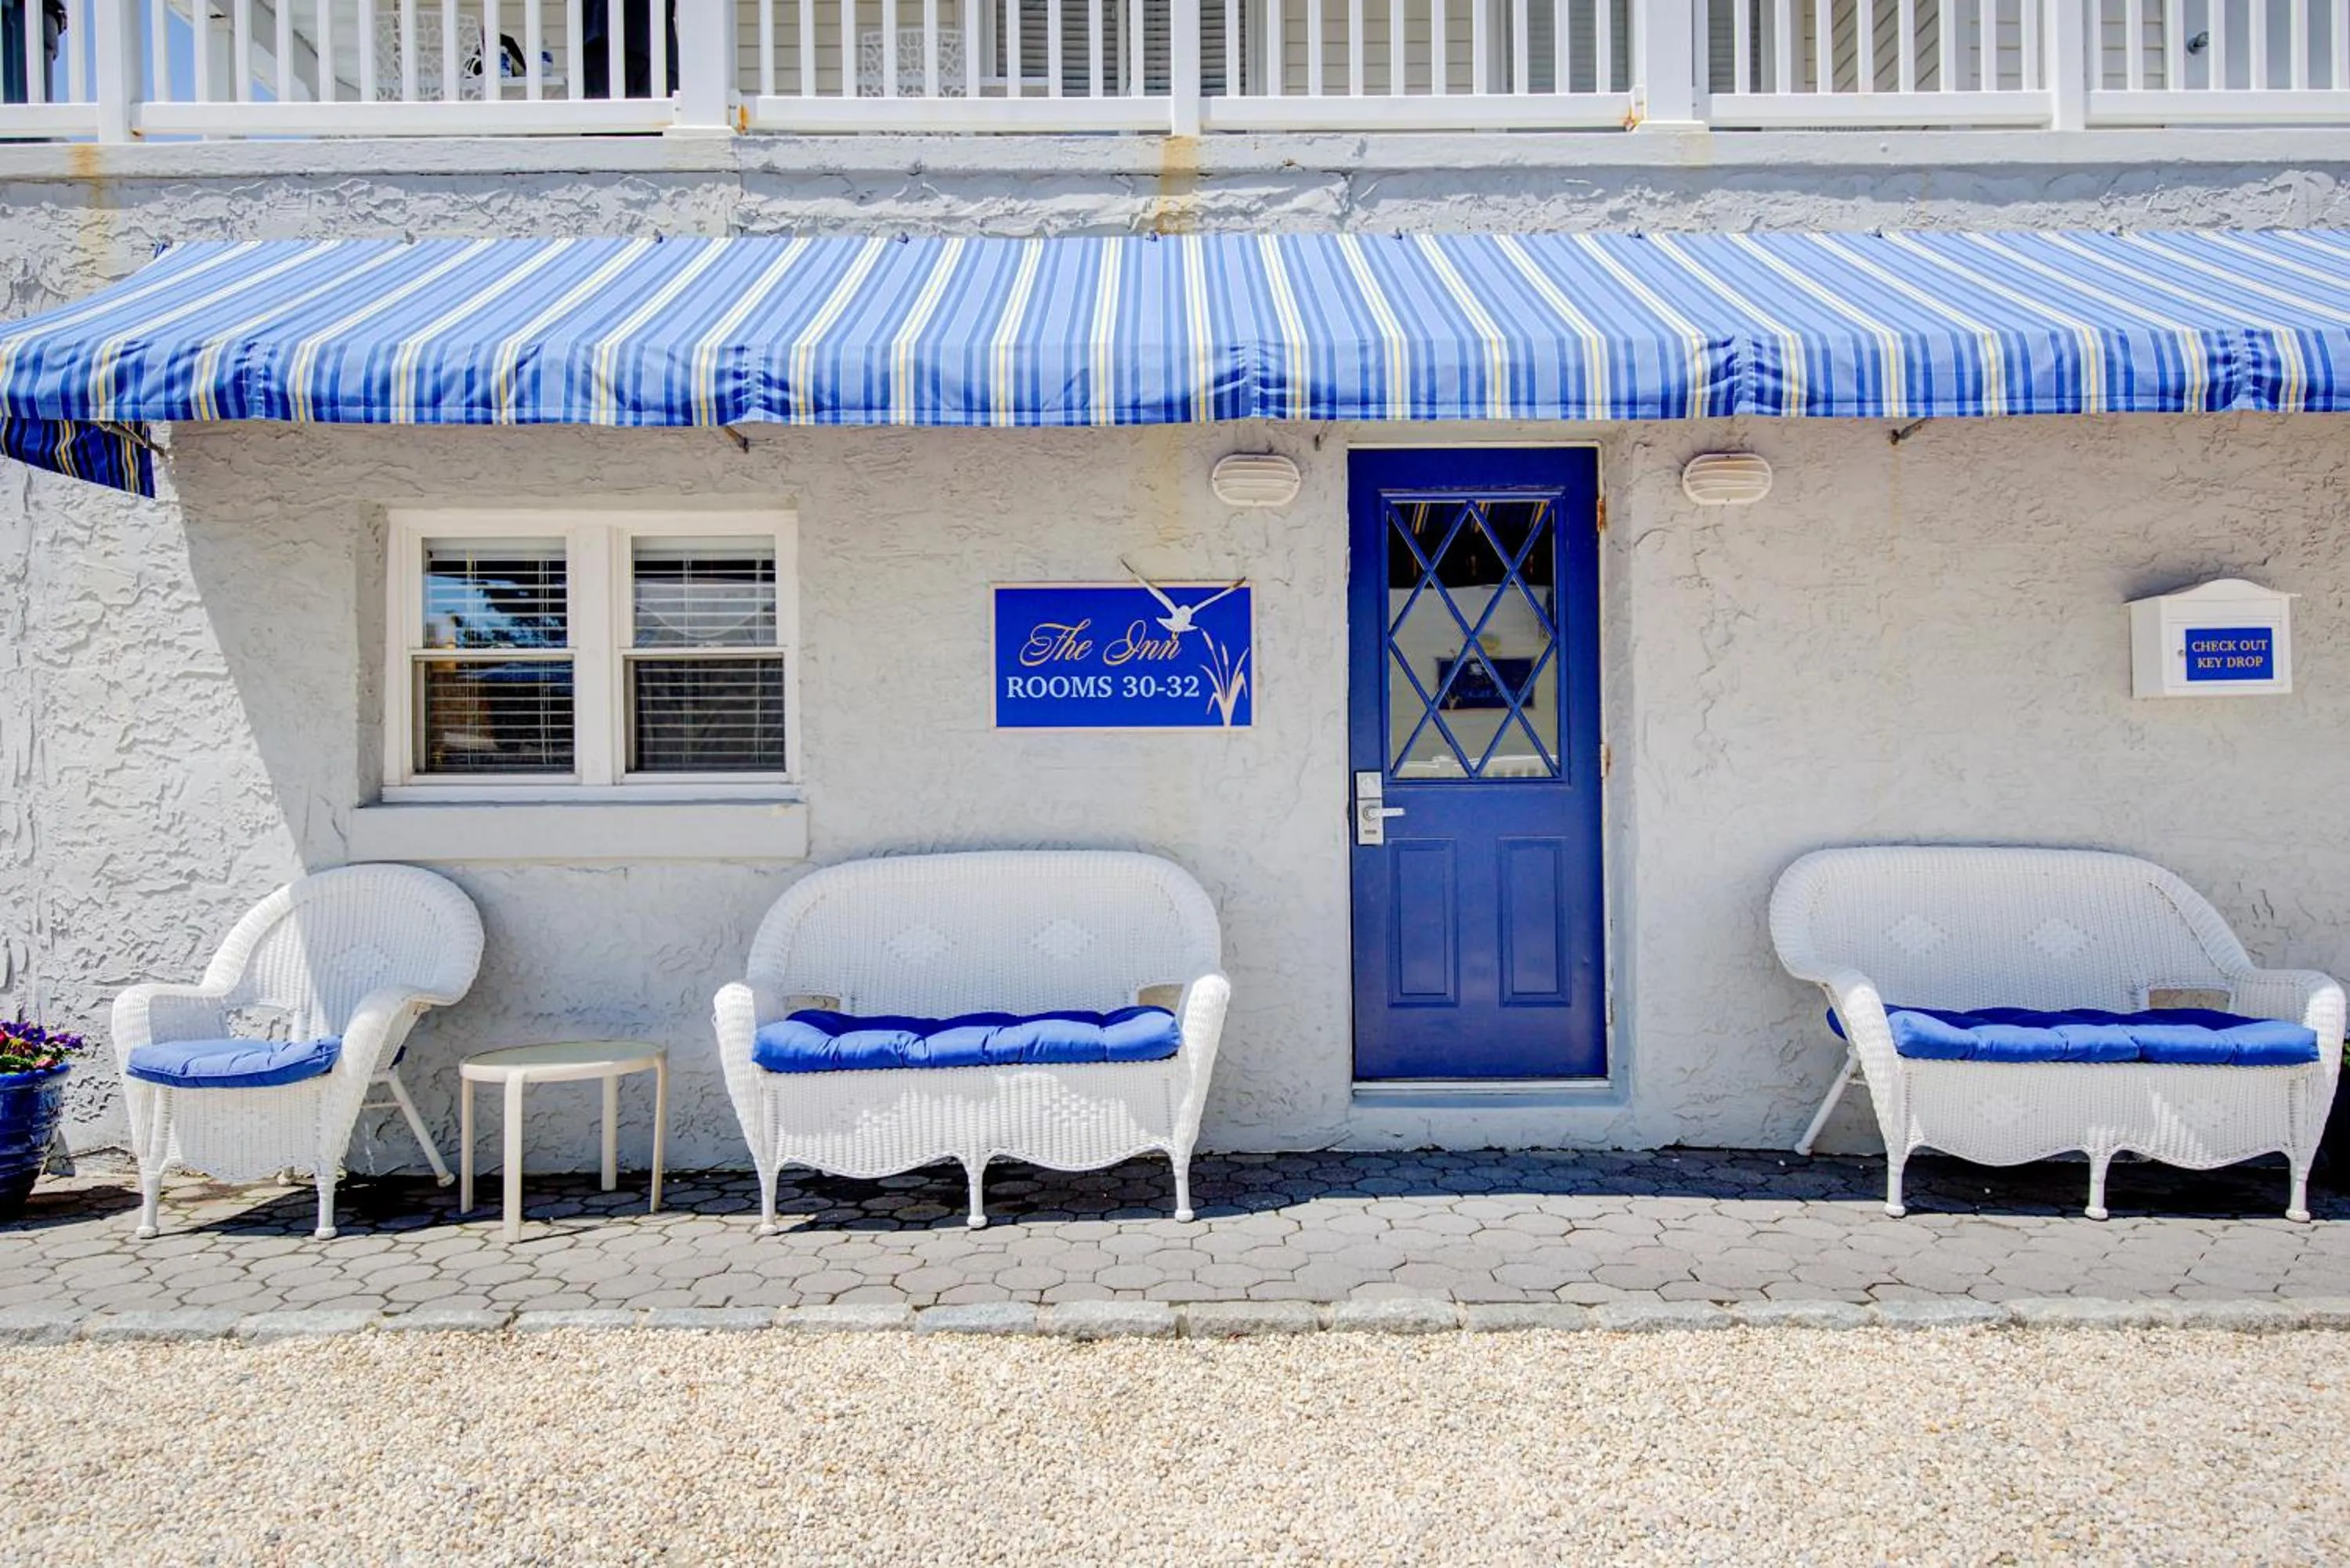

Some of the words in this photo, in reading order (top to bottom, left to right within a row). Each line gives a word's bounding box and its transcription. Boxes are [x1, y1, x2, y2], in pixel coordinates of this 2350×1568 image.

[1019, 619, 1092, 667] The
[1103, 620, 1181, 666] Inn
[2193, 641, 2236, 652] CHECK
[2240, 640, 2268, 651] OUT
[2197, 657, 2222, 668] KEY
[2227, 656, 2263, 667] DROP
[1007, 676, 1112, 698] ROOMS
[1123, 676, 1200, 698] 30-32
